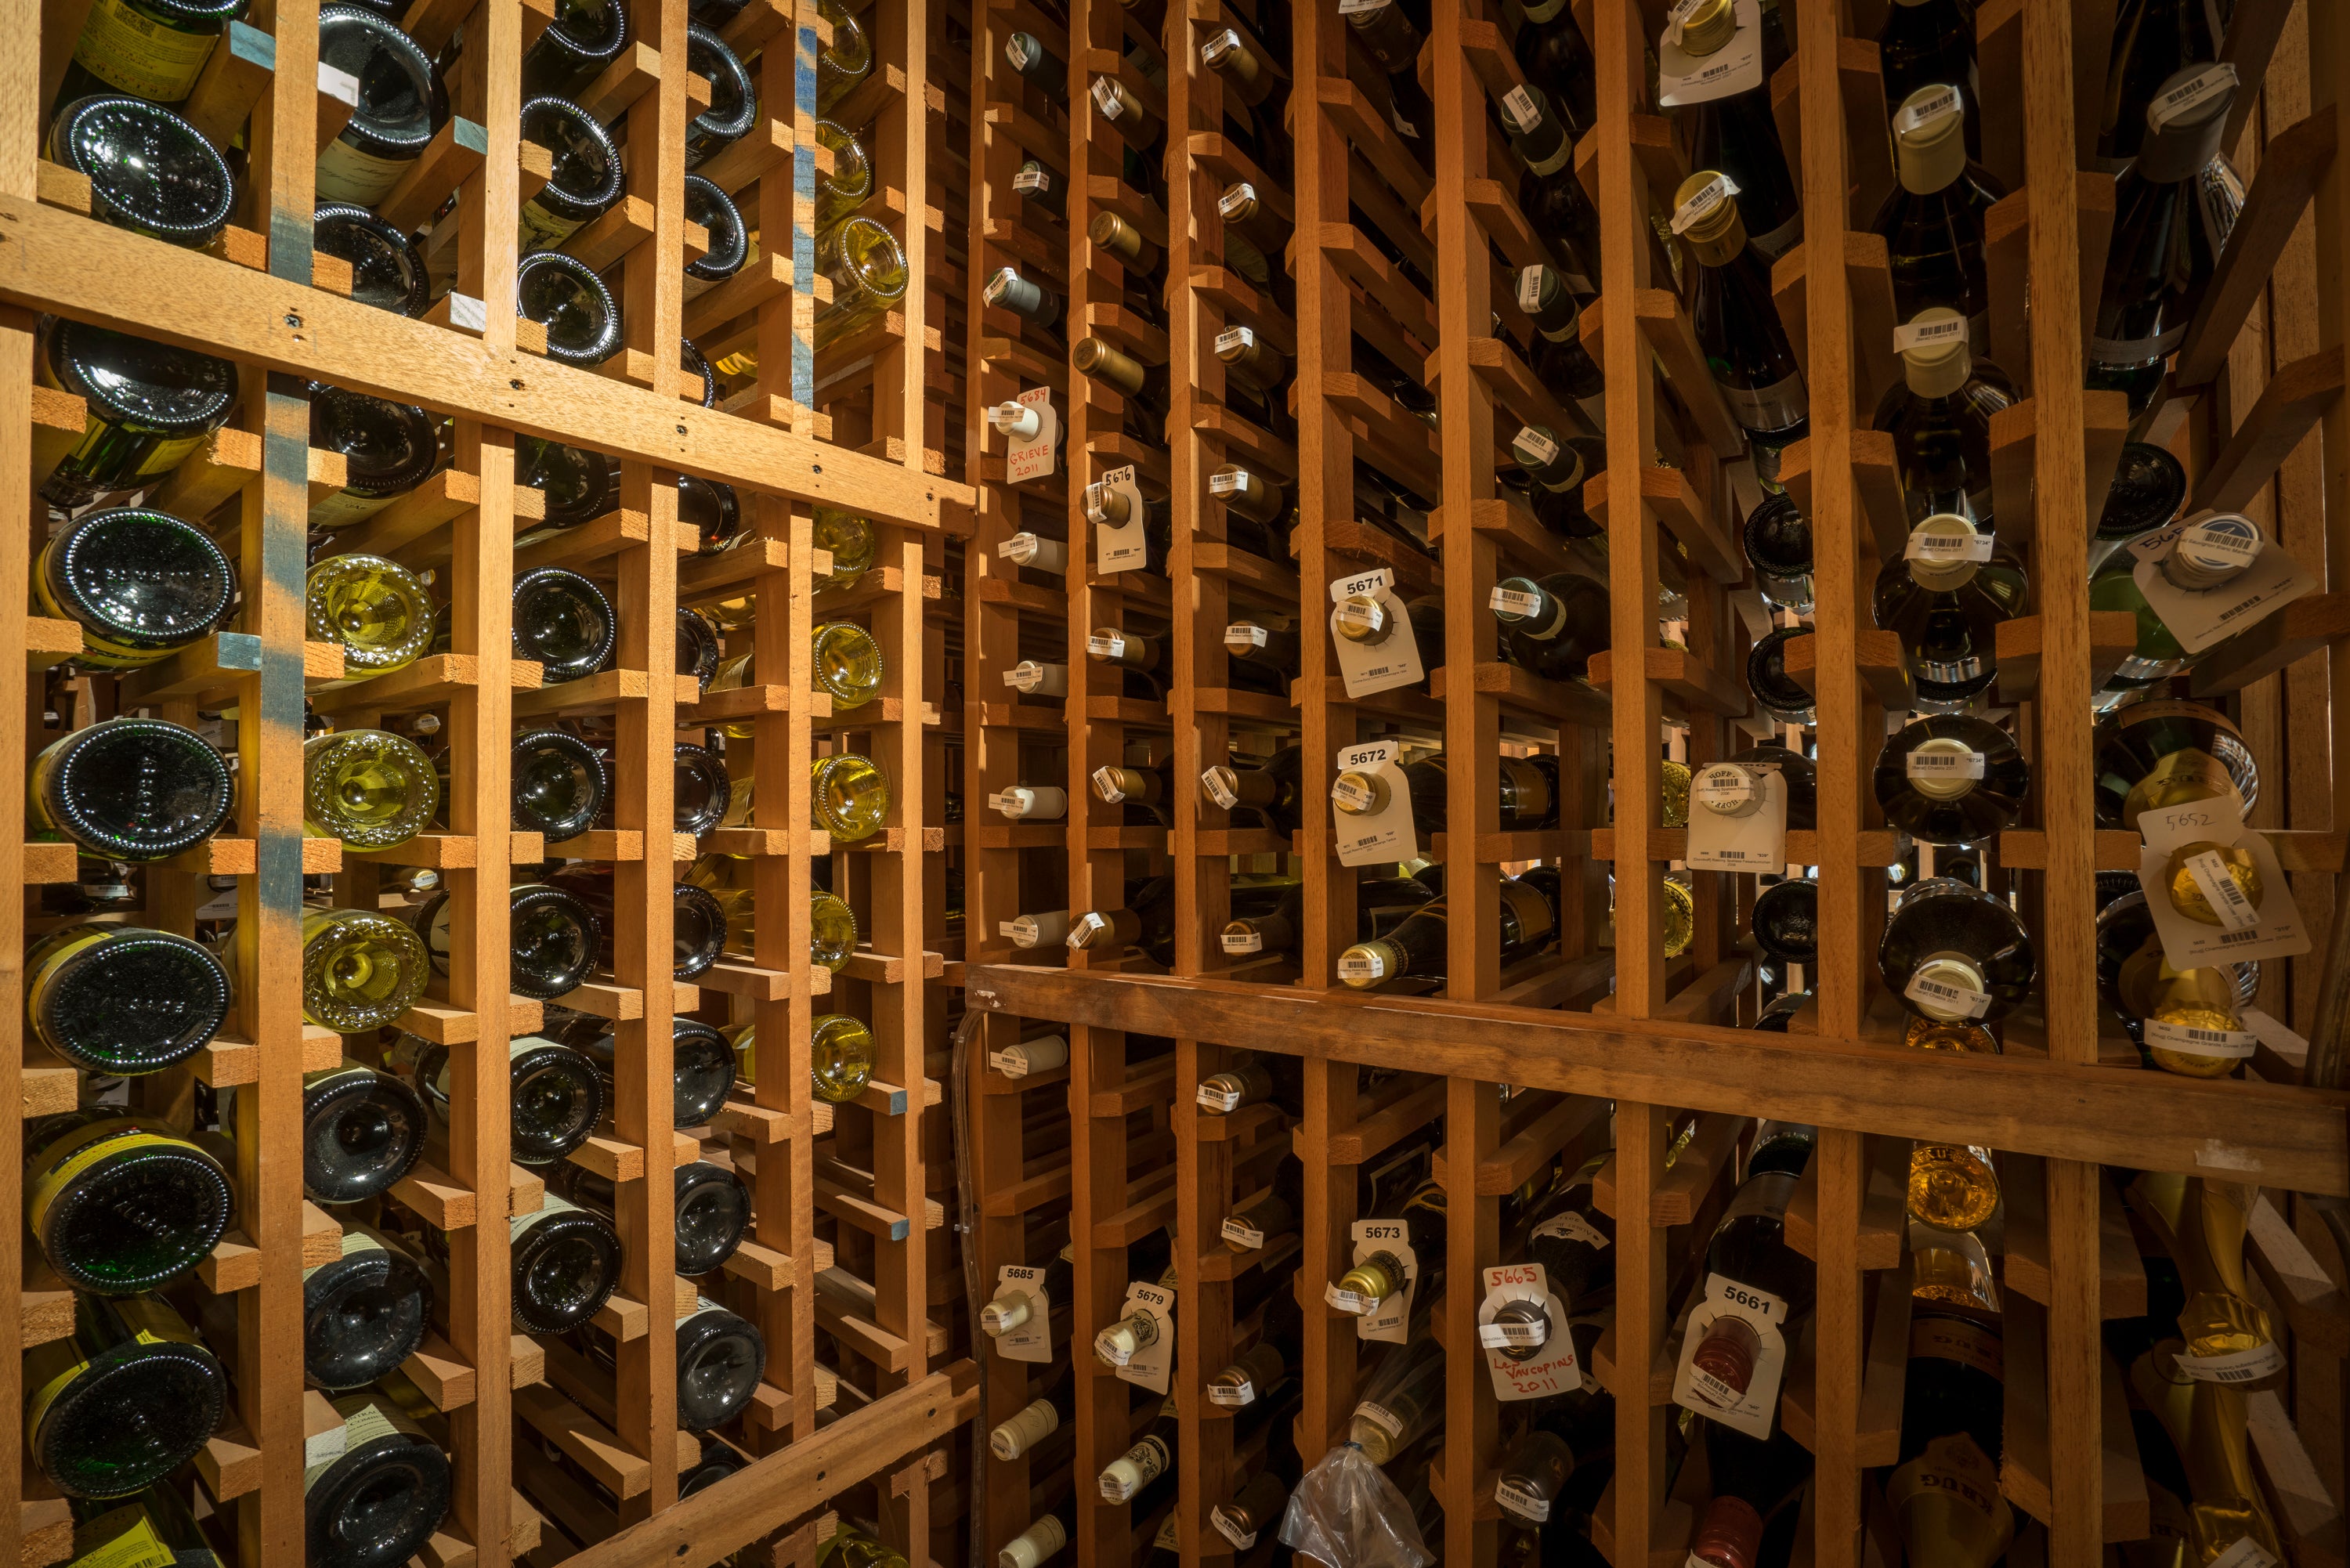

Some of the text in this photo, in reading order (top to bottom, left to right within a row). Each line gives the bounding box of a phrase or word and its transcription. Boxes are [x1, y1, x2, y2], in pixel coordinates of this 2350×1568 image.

[1020, 388, 1046, 406] 5684
[1010, 444, 1049, 465] GRIEVE
[1015, 463, 1039, 476] 2011
[1105, 467, 1131, 486] 5676
[1347, 576, 1383, 594] 5671
[1350, 749, 1386, 765] 5672
[2166, 813, 2218, 831] 5652
[1365, 1227, 1401, 1239] 5673
[1007, 1267, 1034, 1280] 5685
[1491, 1266, 1537, 1287] 5665
[1137, 1289, 1164, 1306] 5679
[1724, 1285, 1771, 1315] 5661
[1513, 1378, 1558, 1393] 2011
